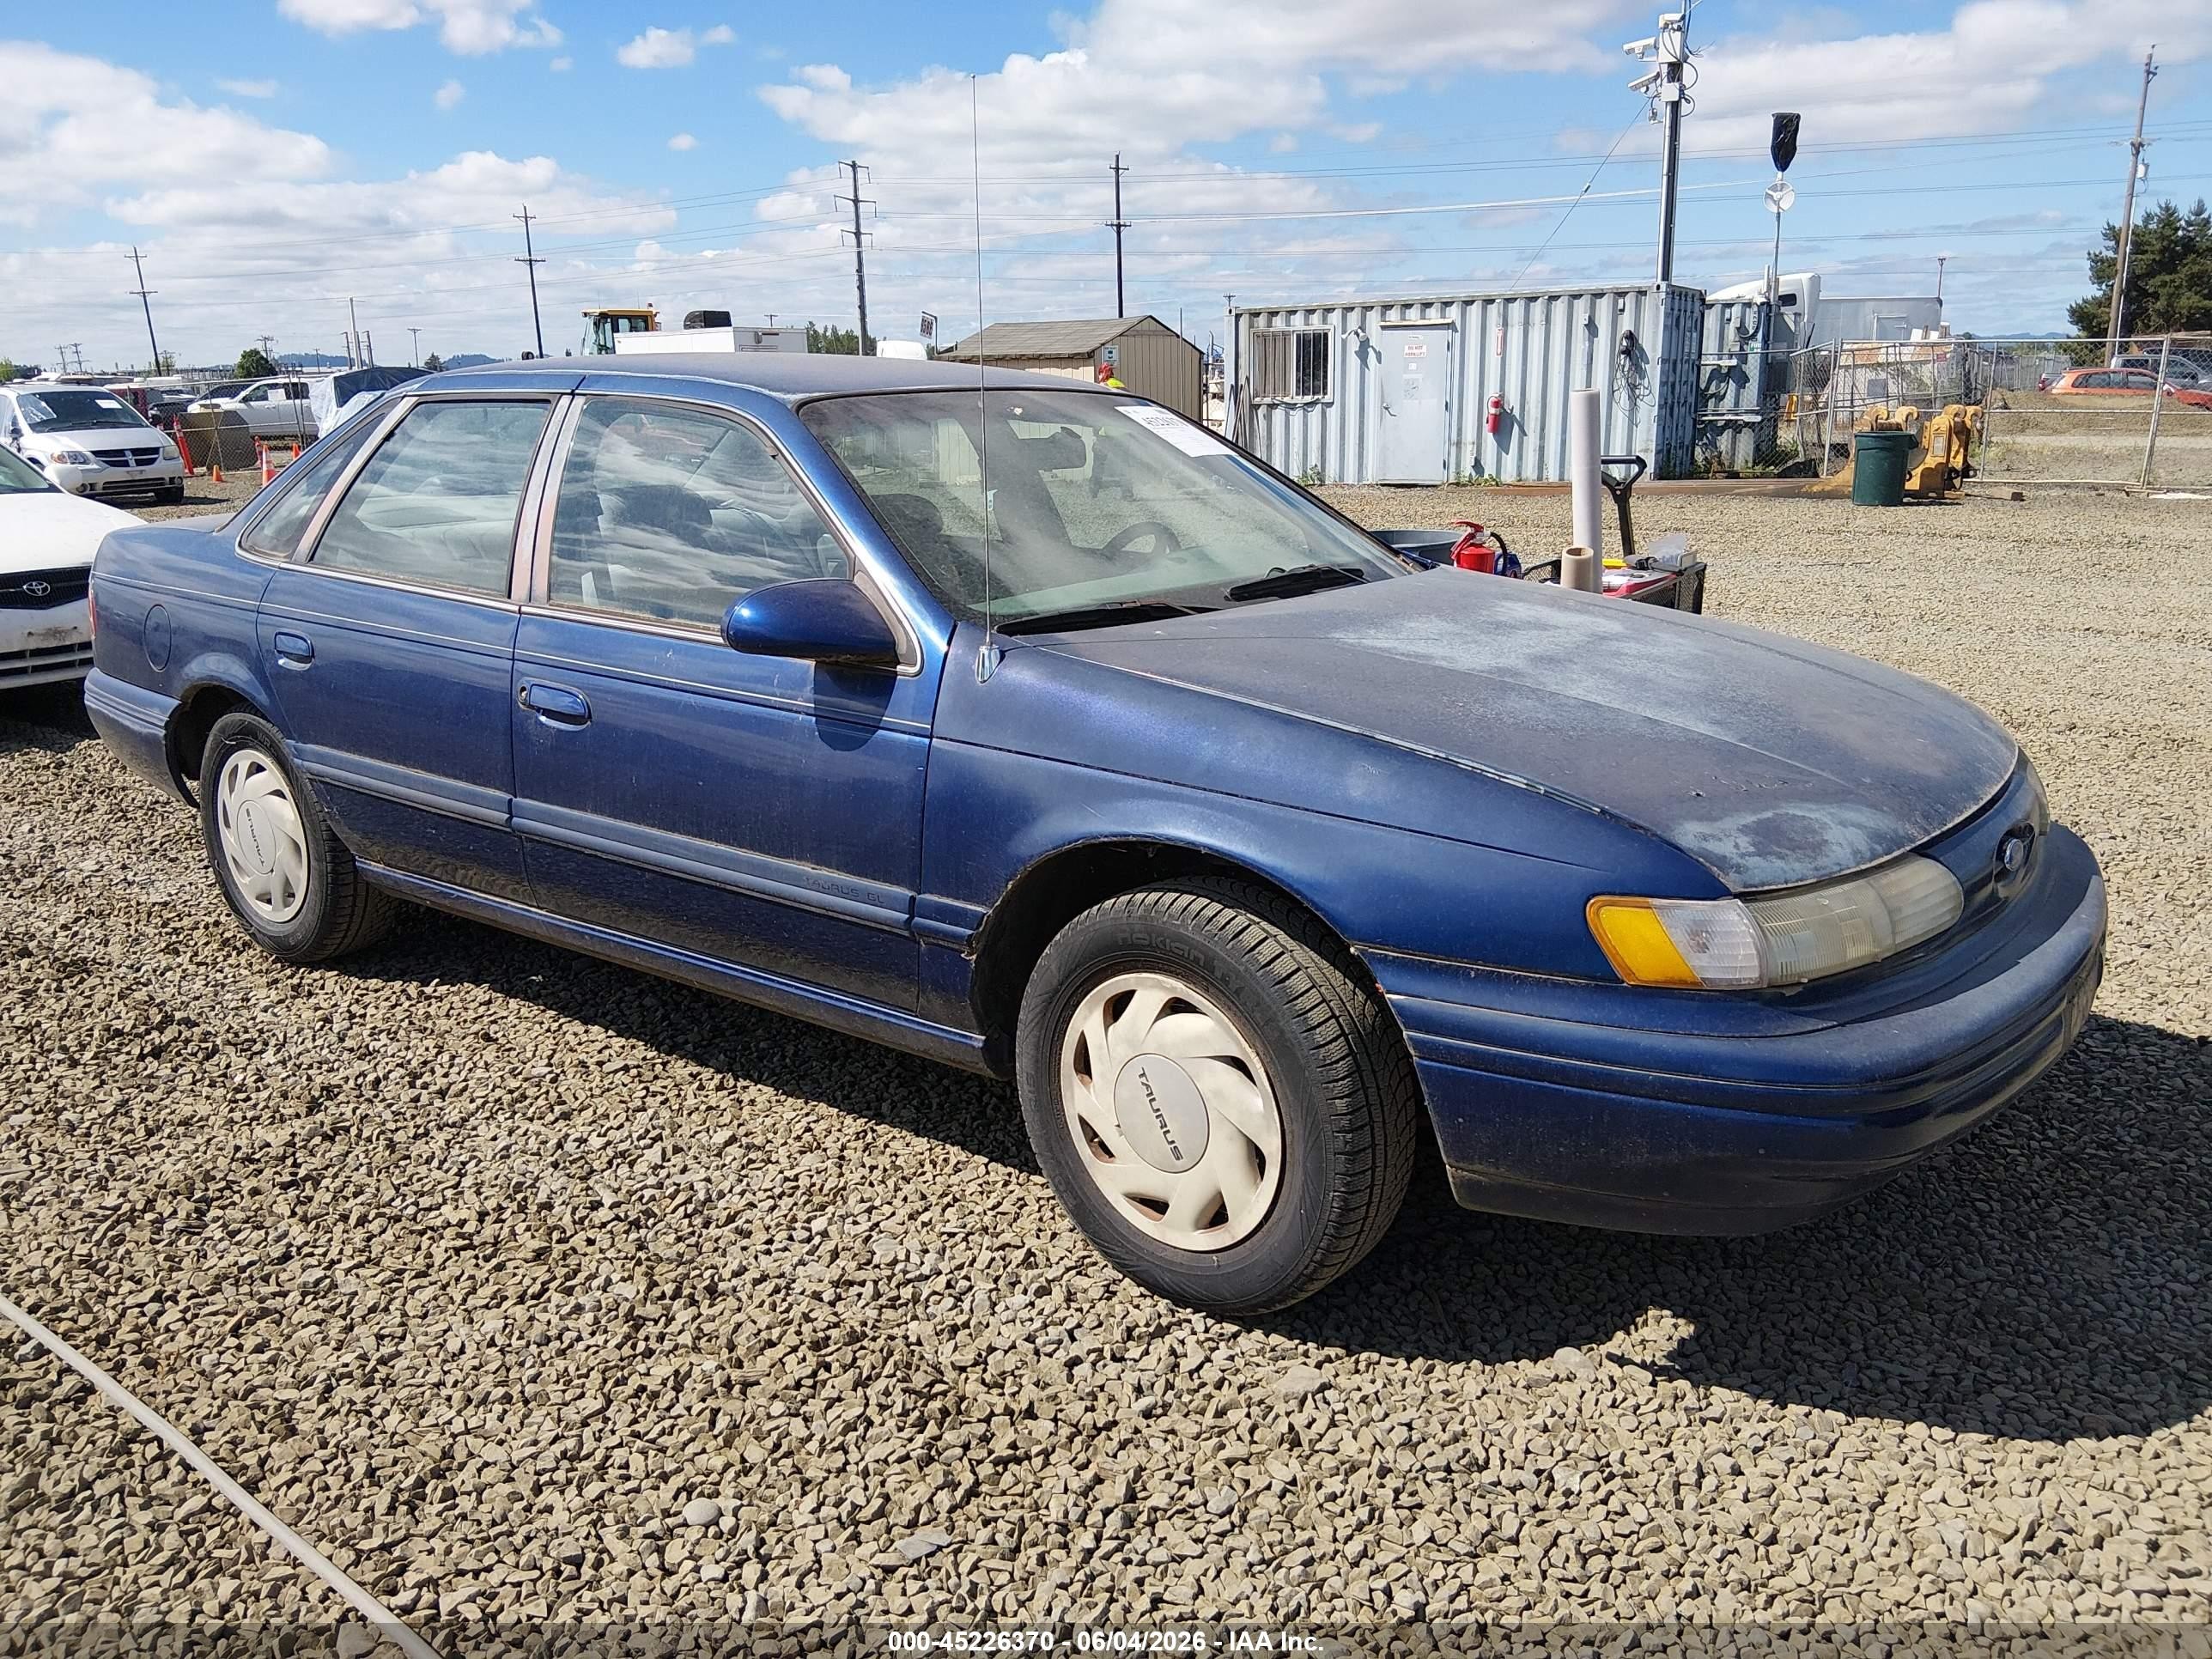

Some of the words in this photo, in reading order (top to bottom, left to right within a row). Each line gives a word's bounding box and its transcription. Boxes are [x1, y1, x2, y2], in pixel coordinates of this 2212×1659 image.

[245, 808, 265, 867] TAURUS
[803, 877, 860, 898] TAURUS
[1138, 1066, 1184, 1162] TAURUS
